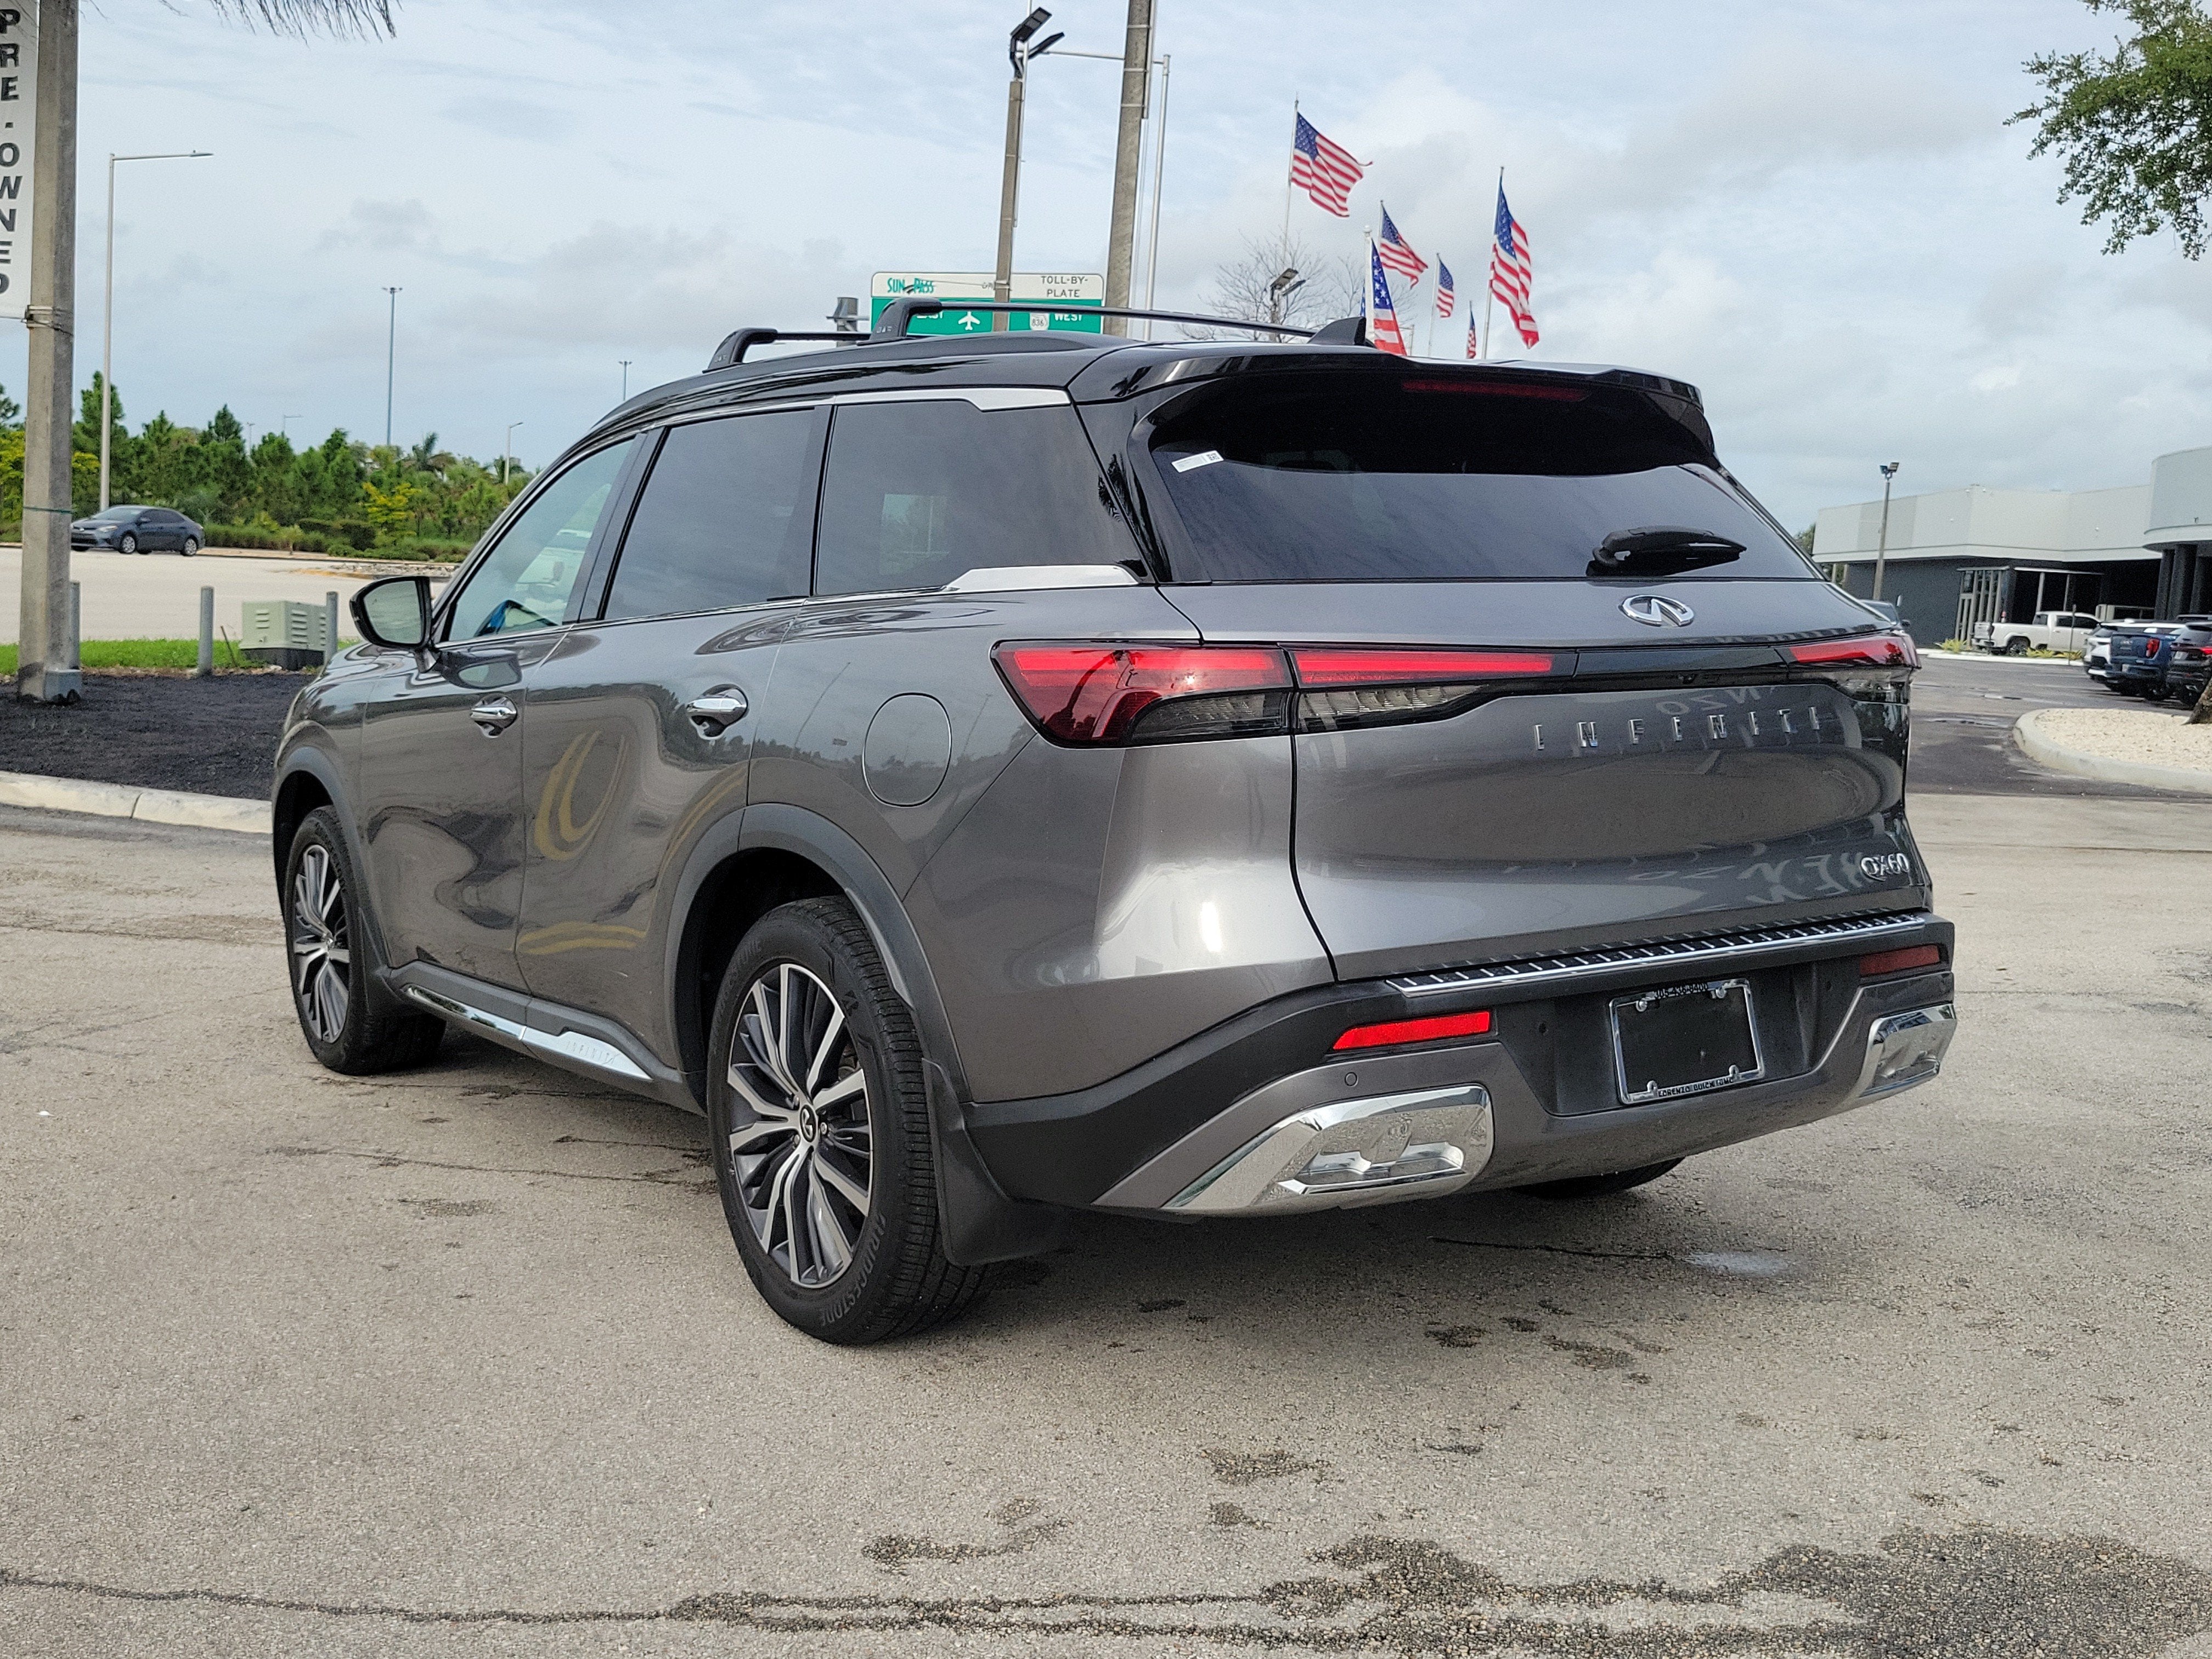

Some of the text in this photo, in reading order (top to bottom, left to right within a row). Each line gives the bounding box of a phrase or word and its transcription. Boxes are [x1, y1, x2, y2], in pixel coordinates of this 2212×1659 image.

[1047, 289, 1080, 297] PLATE
[1534, 706, 1820, 750] INFINITI
[1861, 853, 1909, 881] QX60
[1658, 1086, 1690, 1097] LORENZO
[1692, 1081, 1715, 1091] BUICK
